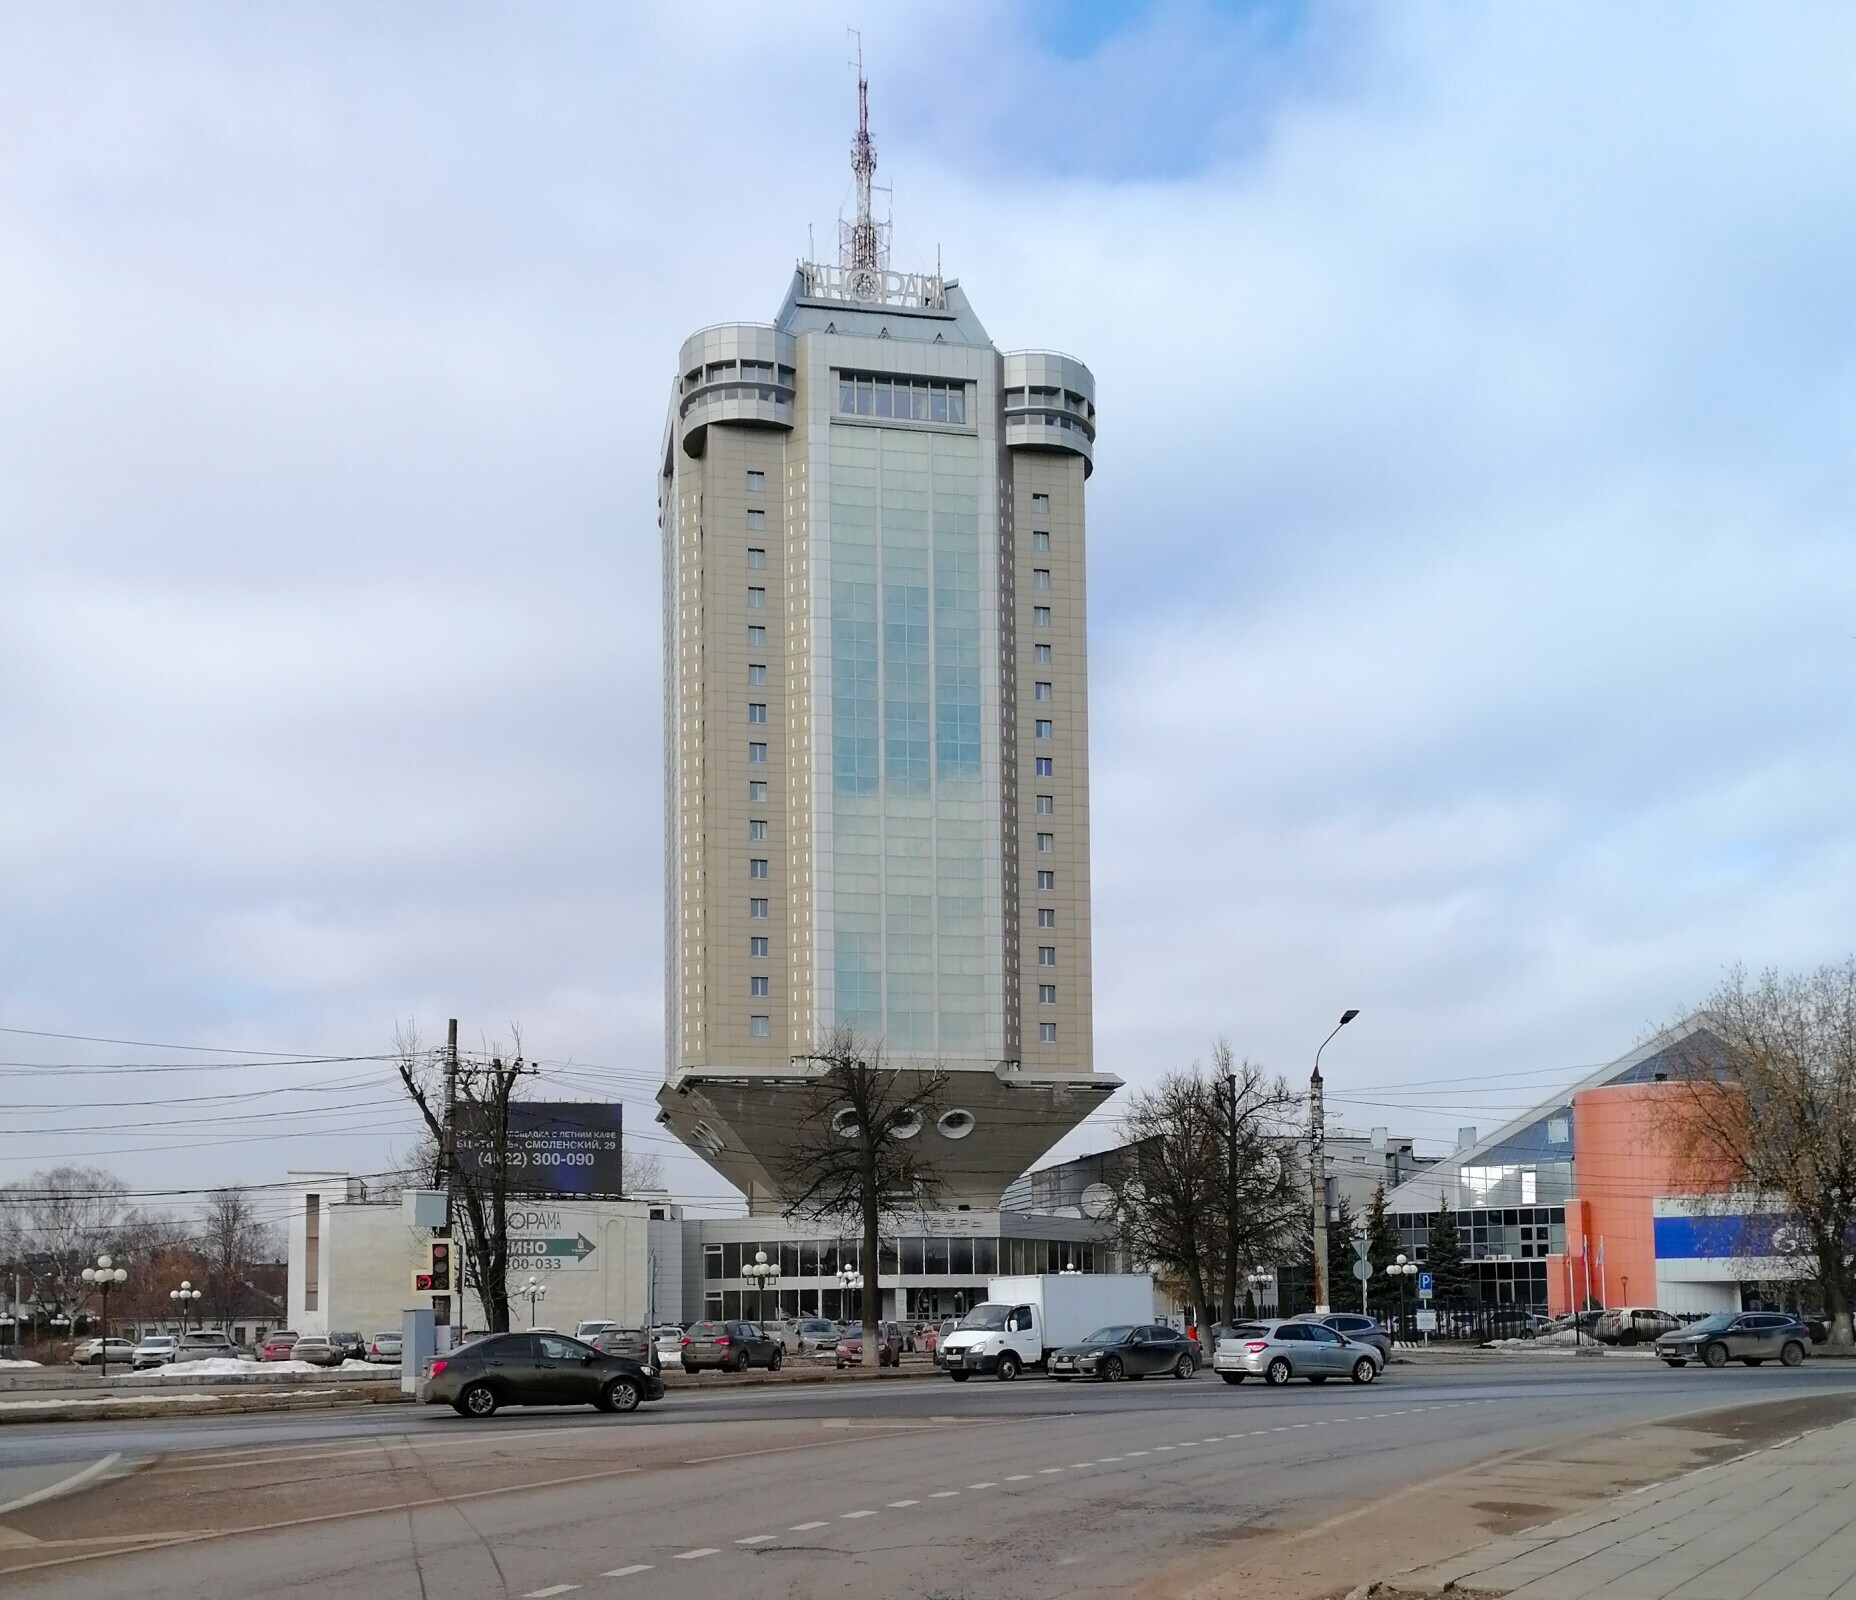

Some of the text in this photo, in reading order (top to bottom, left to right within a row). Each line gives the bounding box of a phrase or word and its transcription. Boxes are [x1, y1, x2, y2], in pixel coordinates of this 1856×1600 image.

[525, 1140, 602, 1150] СМОЛЕНСКИЙ,
[604, 1141, 616, 1150] 29
[478, 1151, 595, 1168] (422) 300-090
[506, 1212, 562, 1230] ОРАМА
